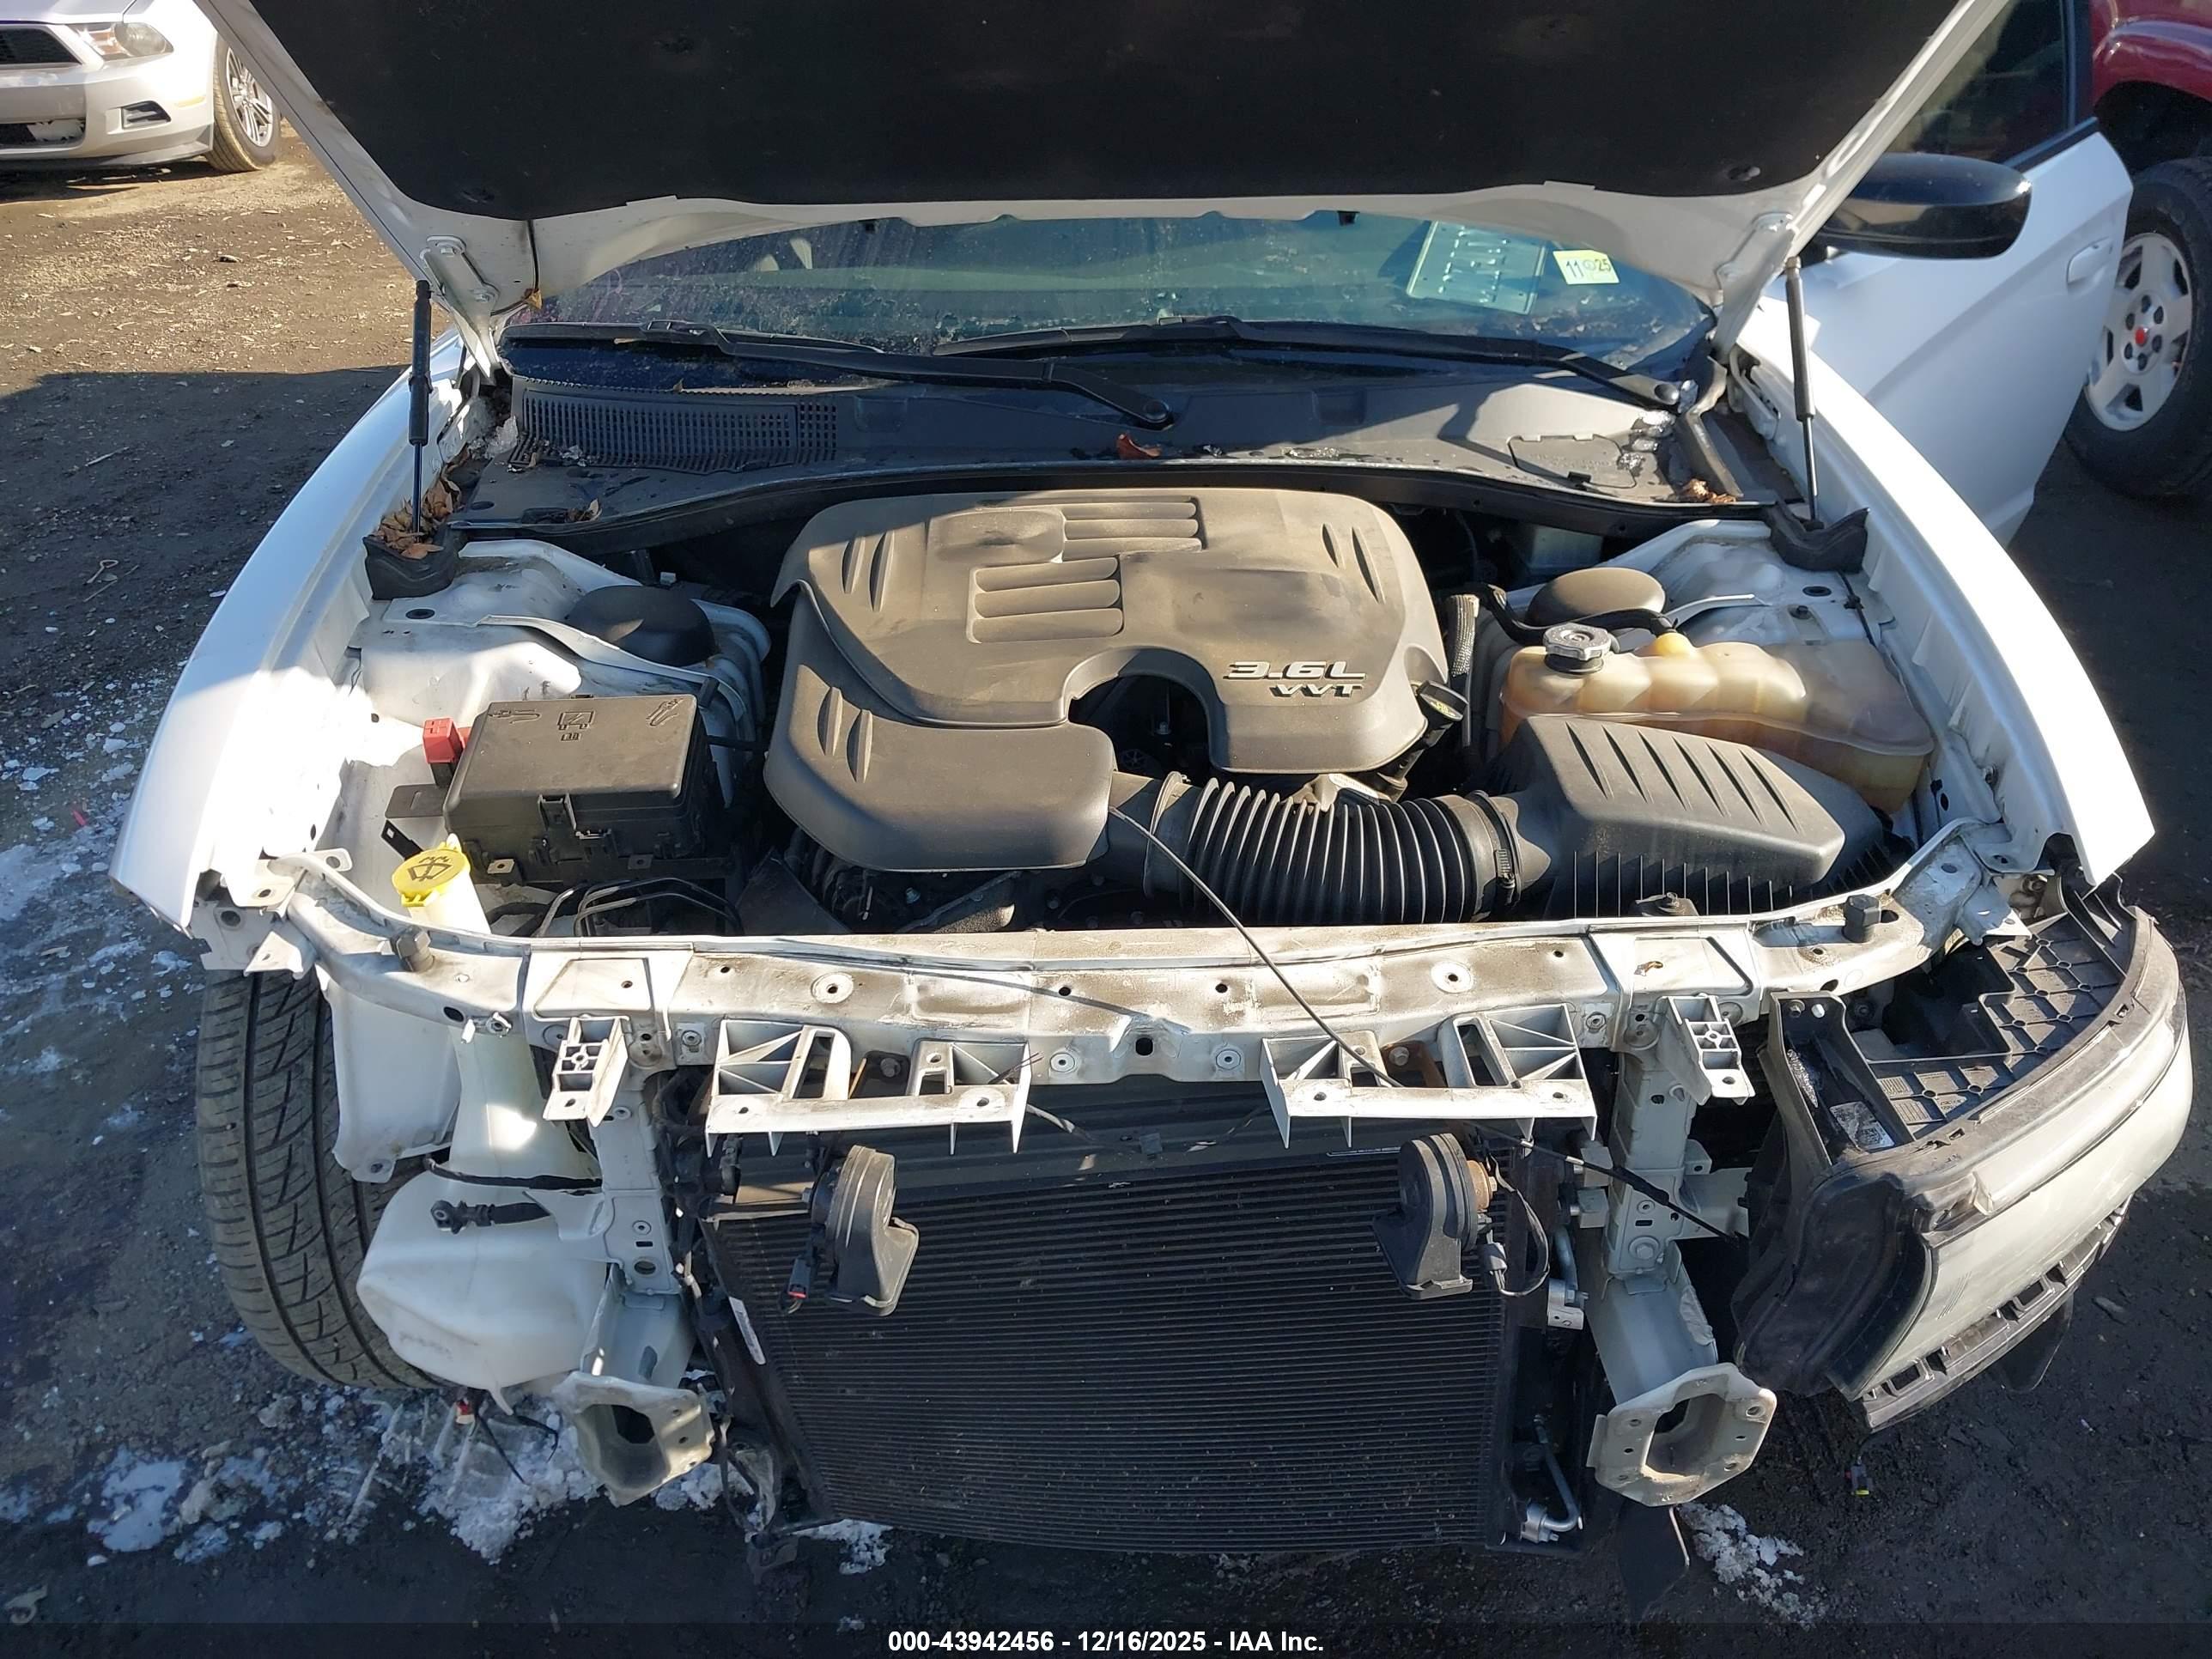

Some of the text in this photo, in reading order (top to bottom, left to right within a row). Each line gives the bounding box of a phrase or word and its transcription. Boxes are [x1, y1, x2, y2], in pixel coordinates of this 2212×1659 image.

[1566, 258, 1612, 278] 11 25
[1224, 660, 1367, 680] 3.6L
[1269, 684, 1364, 698] VVT
